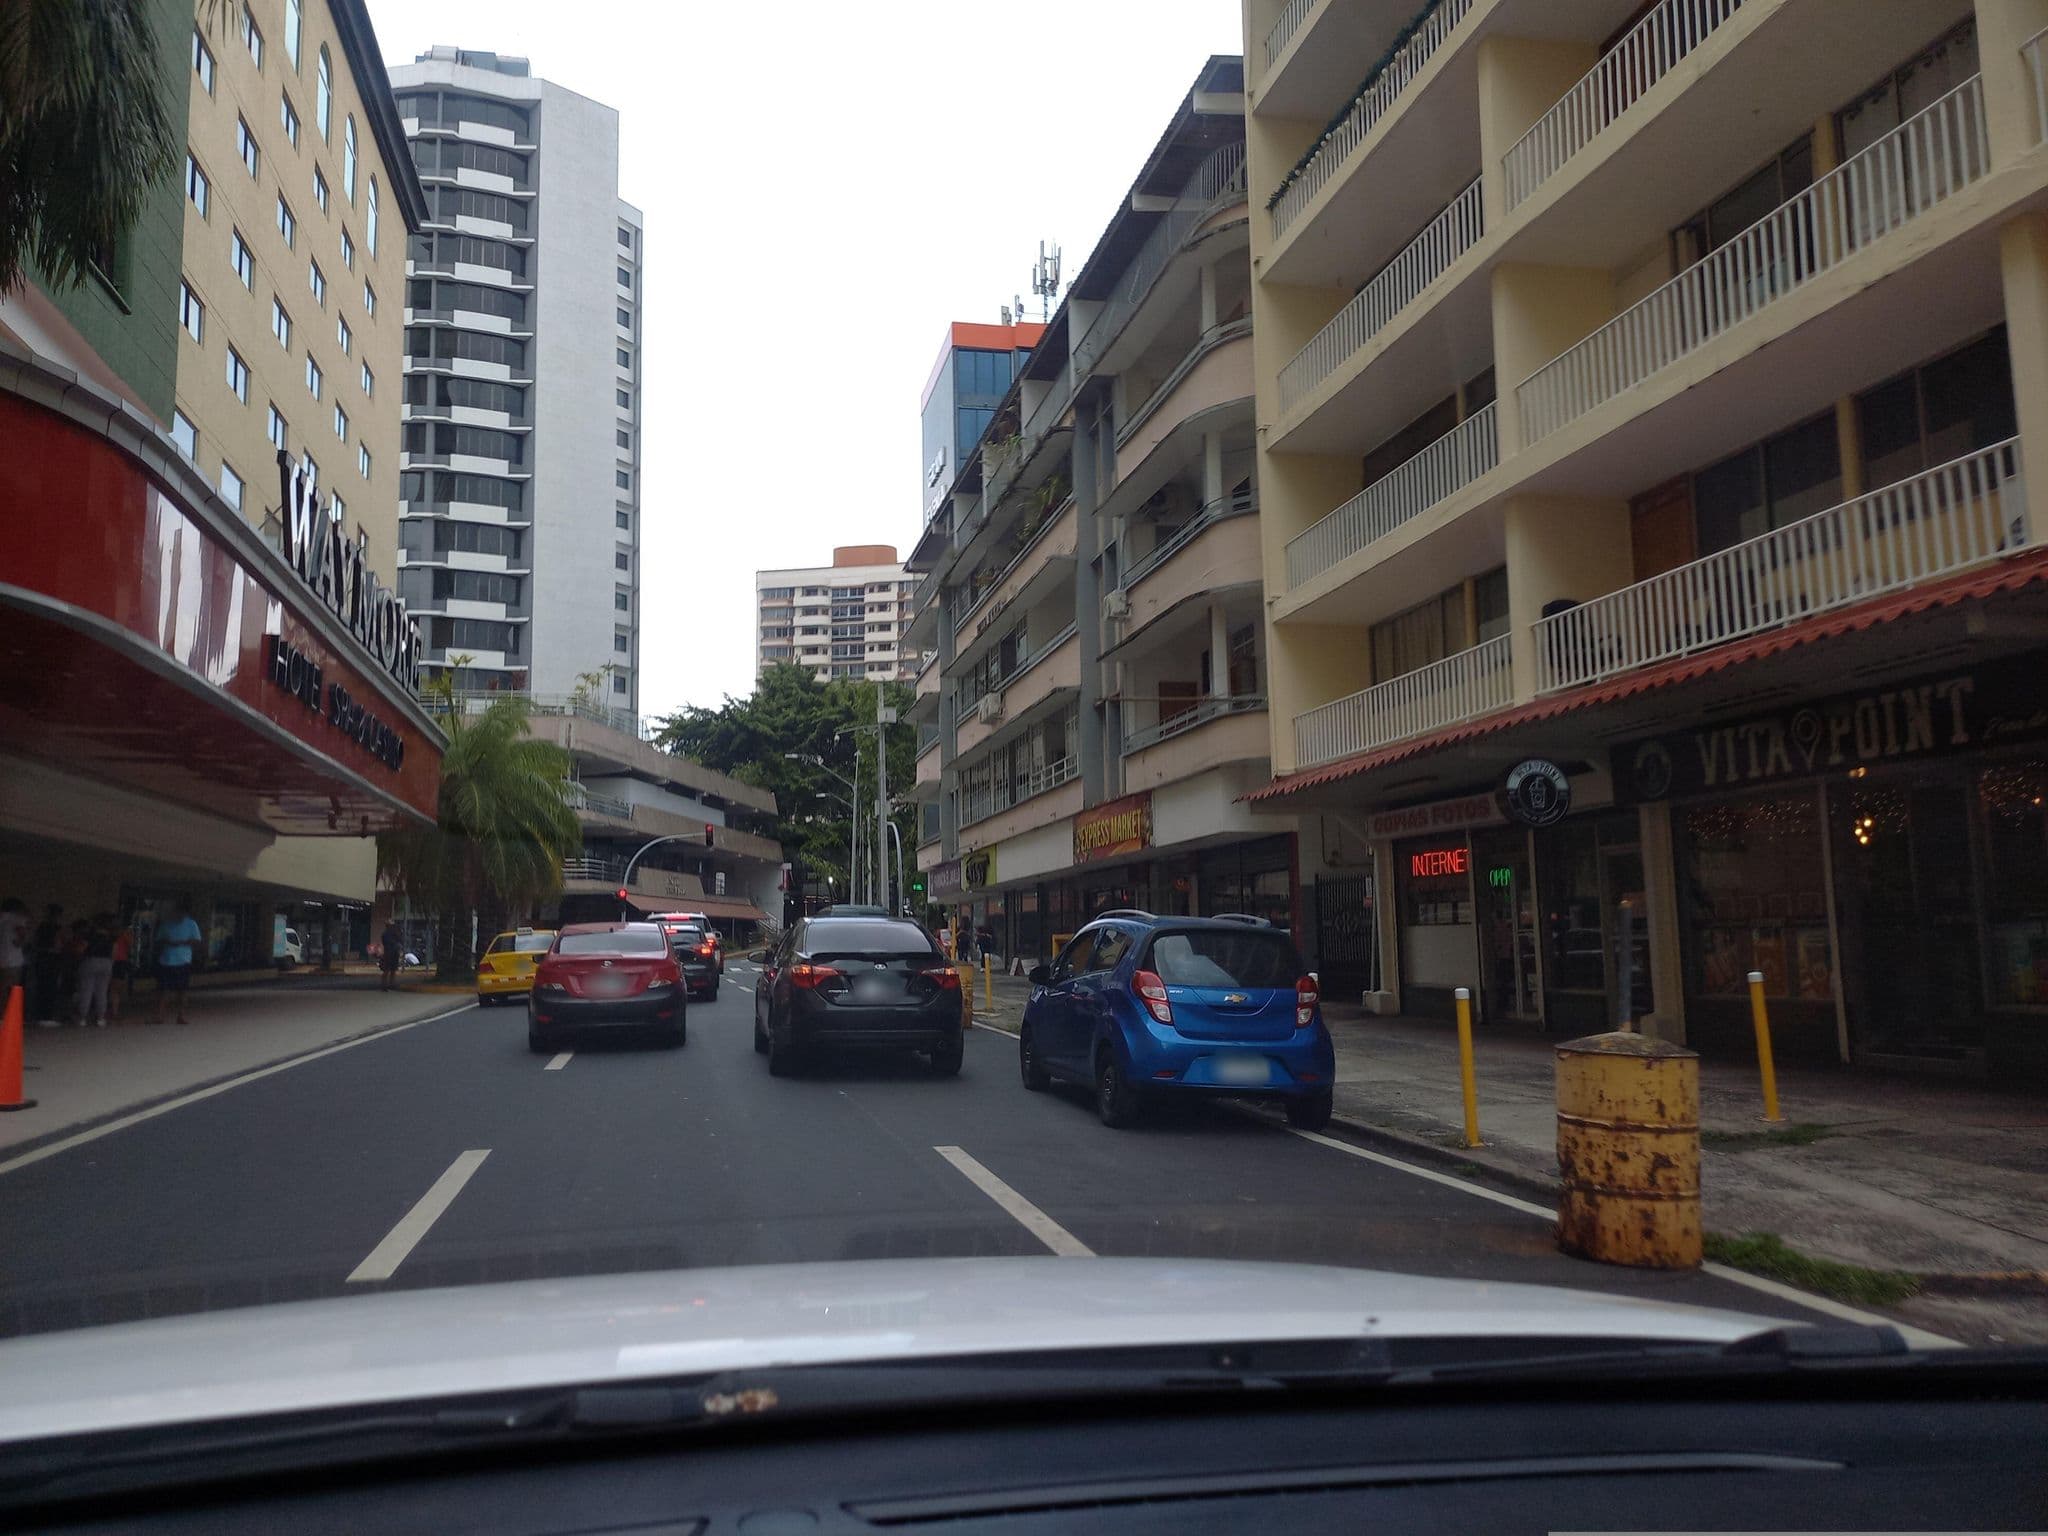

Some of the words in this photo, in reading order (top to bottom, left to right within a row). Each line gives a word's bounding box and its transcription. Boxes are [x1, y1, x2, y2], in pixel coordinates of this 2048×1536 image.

[268, 635, 325, 716] HOTEL
[1696, 716, 1792, 785] VITA
[1823, 675, 1975, 766] POINT
[1080, 818, 1110, 850] EXPRESS
[1110, 808, 1143, 843] MARKET
[1373, 807, 1428, 834] COPIAS
[1431, 797, 1491, 825] FOTOS
